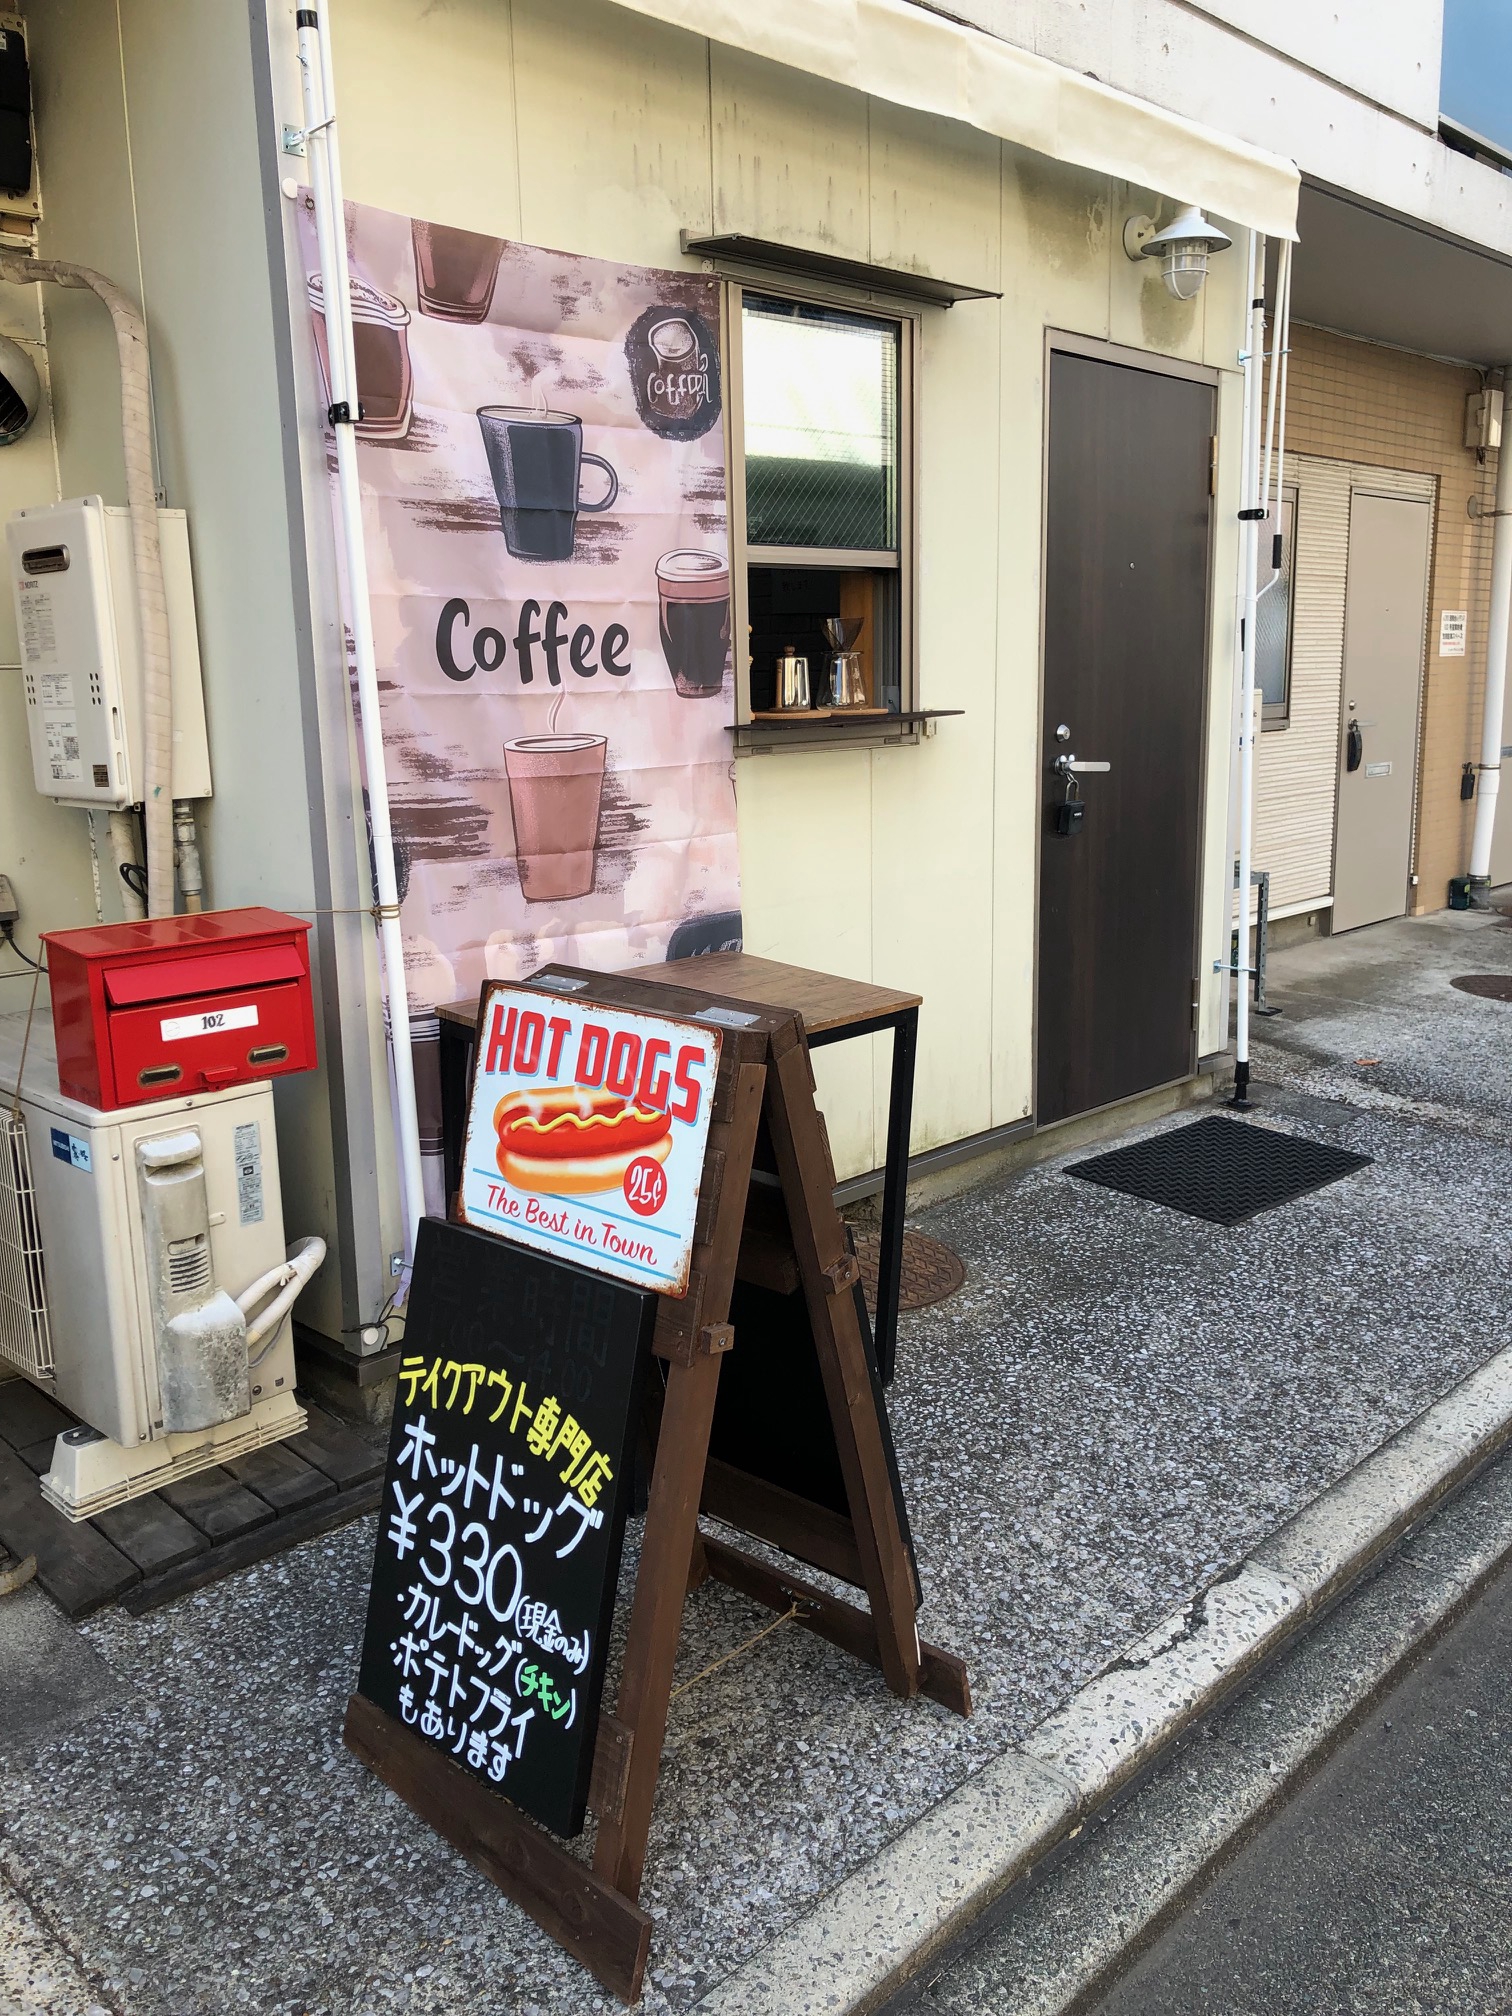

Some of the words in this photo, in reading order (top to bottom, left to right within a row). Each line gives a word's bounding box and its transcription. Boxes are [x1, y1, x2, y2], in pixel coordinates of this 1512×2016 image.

[435, 597, 632, 687] Coffee
[201, 1013, 226, 1030] 102
[484, 1003, 573, 1082] HOT
[574, 1022, 706, 1127] DOGS
[486, 1184, 521, 1218] The
[525, 1197, 570, 1236] Best
[573, 1217, 598, 1246] in
[601, 1222, 659, 1265] Town
[398, 1355, 614, 1508] テイクアウト専門店
[396, 1414, 605, 1559] ホットドッグ
[398, 1683, 514, 1783] もあります
